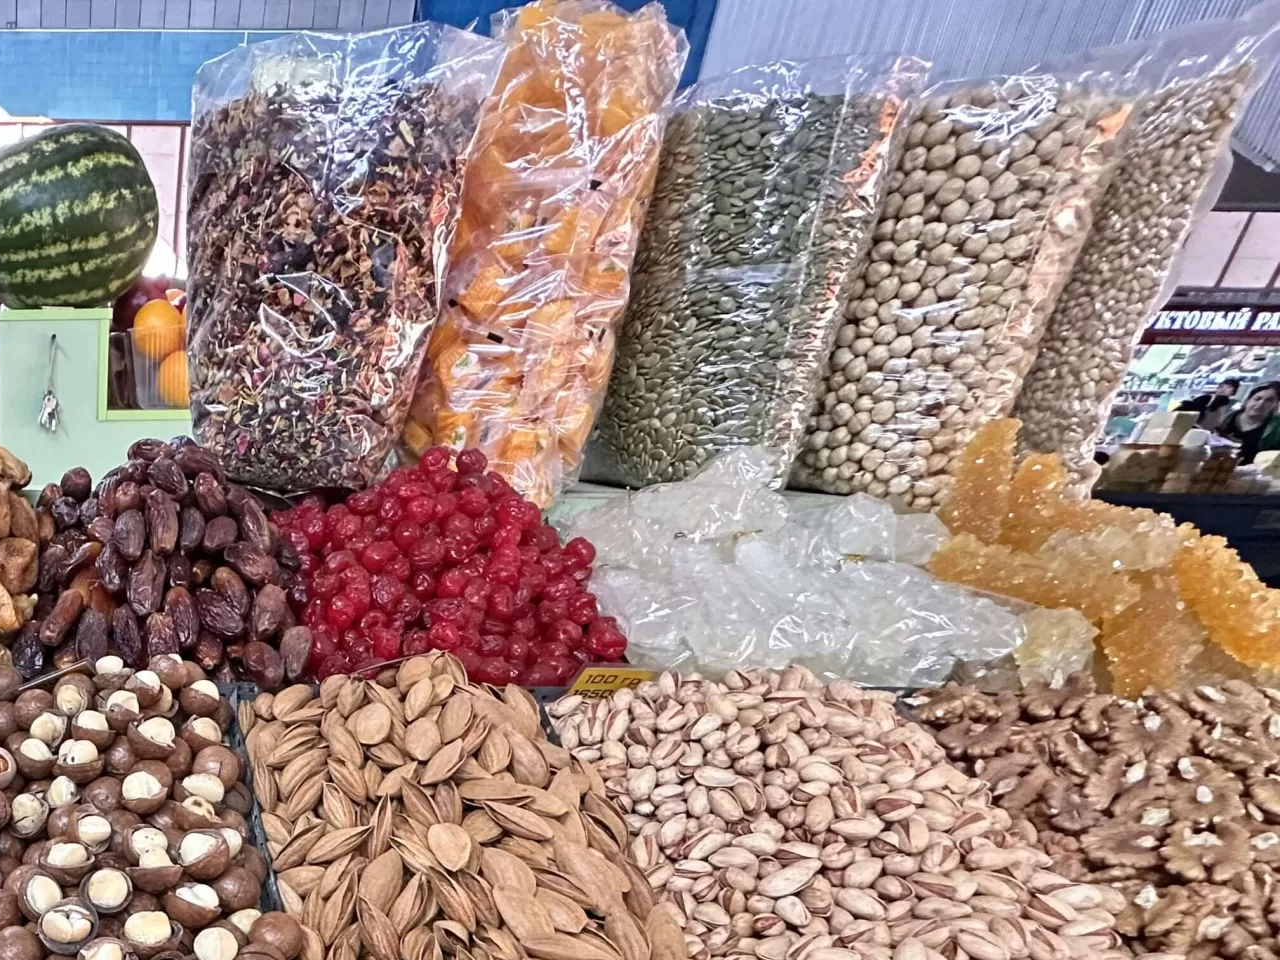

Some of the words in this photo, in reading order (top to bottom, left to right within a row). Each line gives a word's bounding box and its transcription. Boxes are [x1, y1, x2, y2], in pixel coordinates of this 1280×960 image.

[1251, 311, 1280, 331] РА
[585, 674, 619, 684] 100
[620, 678, 642, 689] гр
